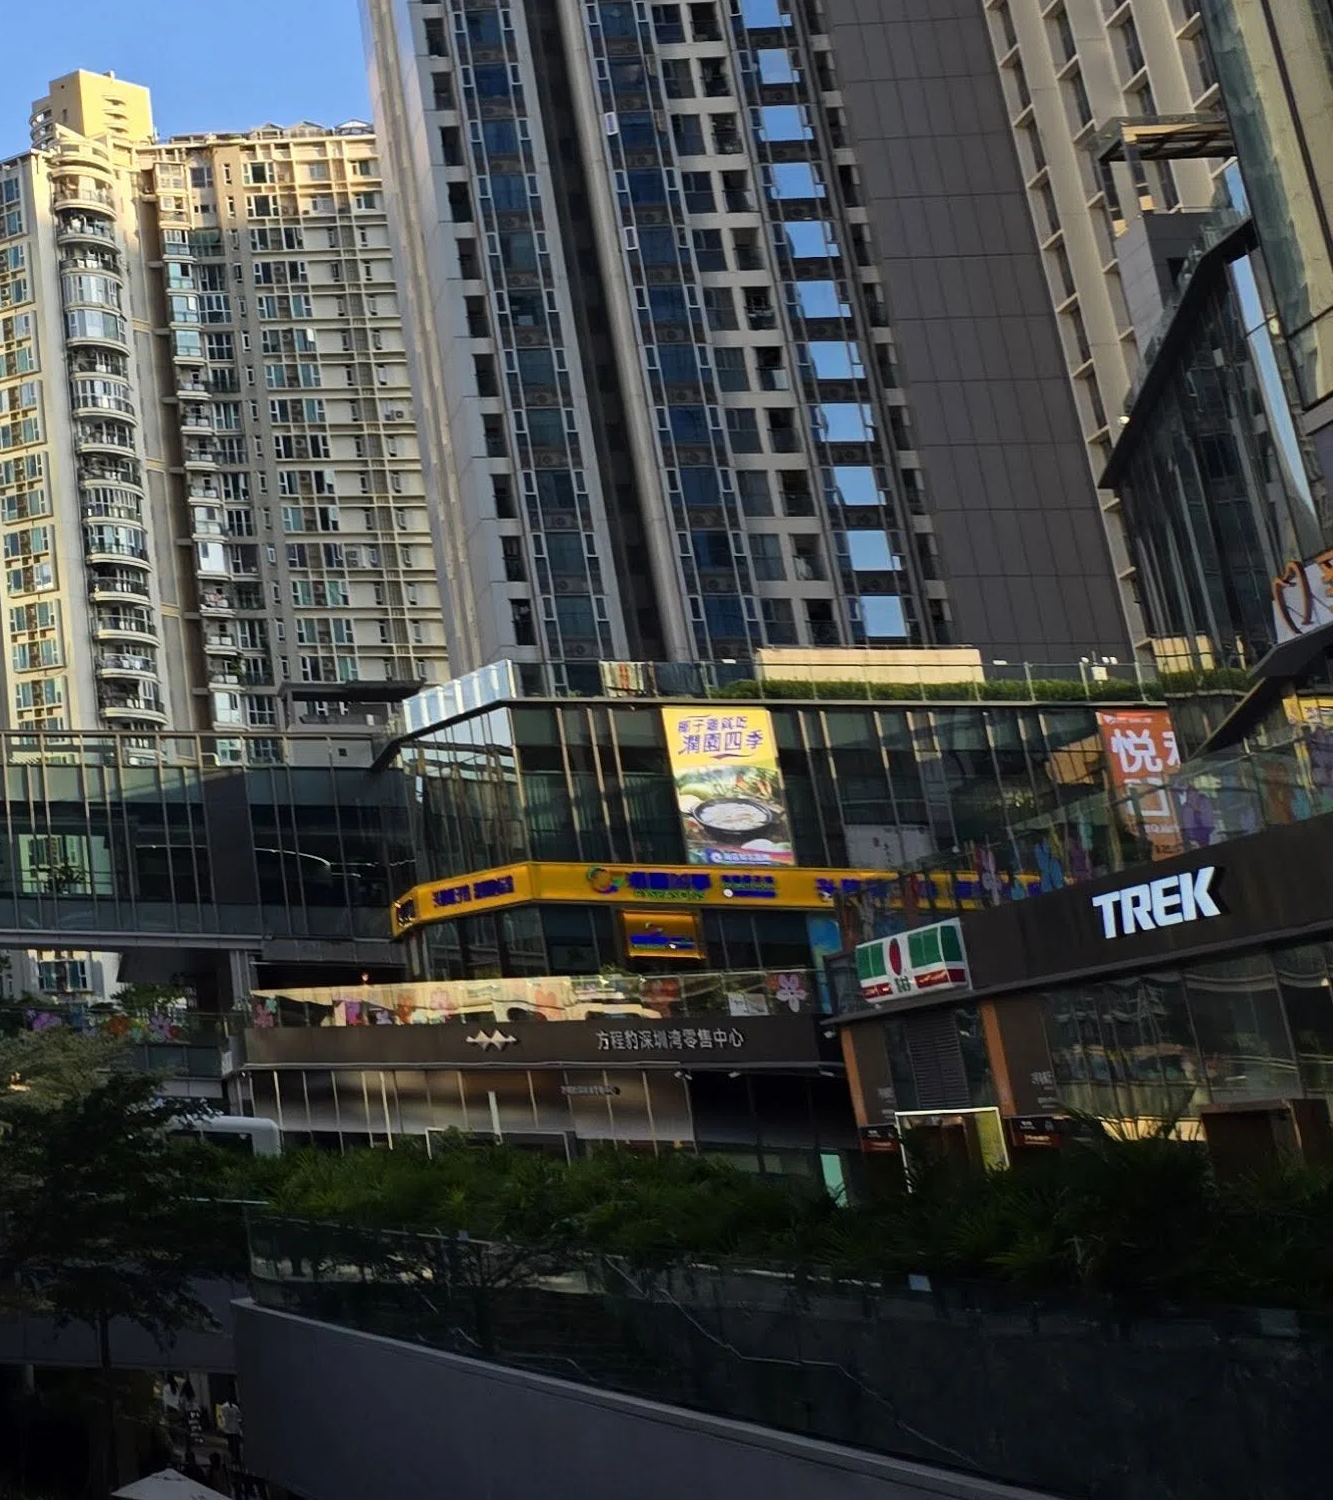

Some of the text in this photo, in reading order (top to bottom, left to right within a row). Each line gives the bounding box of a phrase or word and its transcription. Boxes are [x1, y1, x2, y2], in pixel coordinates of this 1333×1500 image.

[1092, 866, 1221, 939] TREK
[596, 1028, 744, 1049] 方程豹深圳湾零售中心
